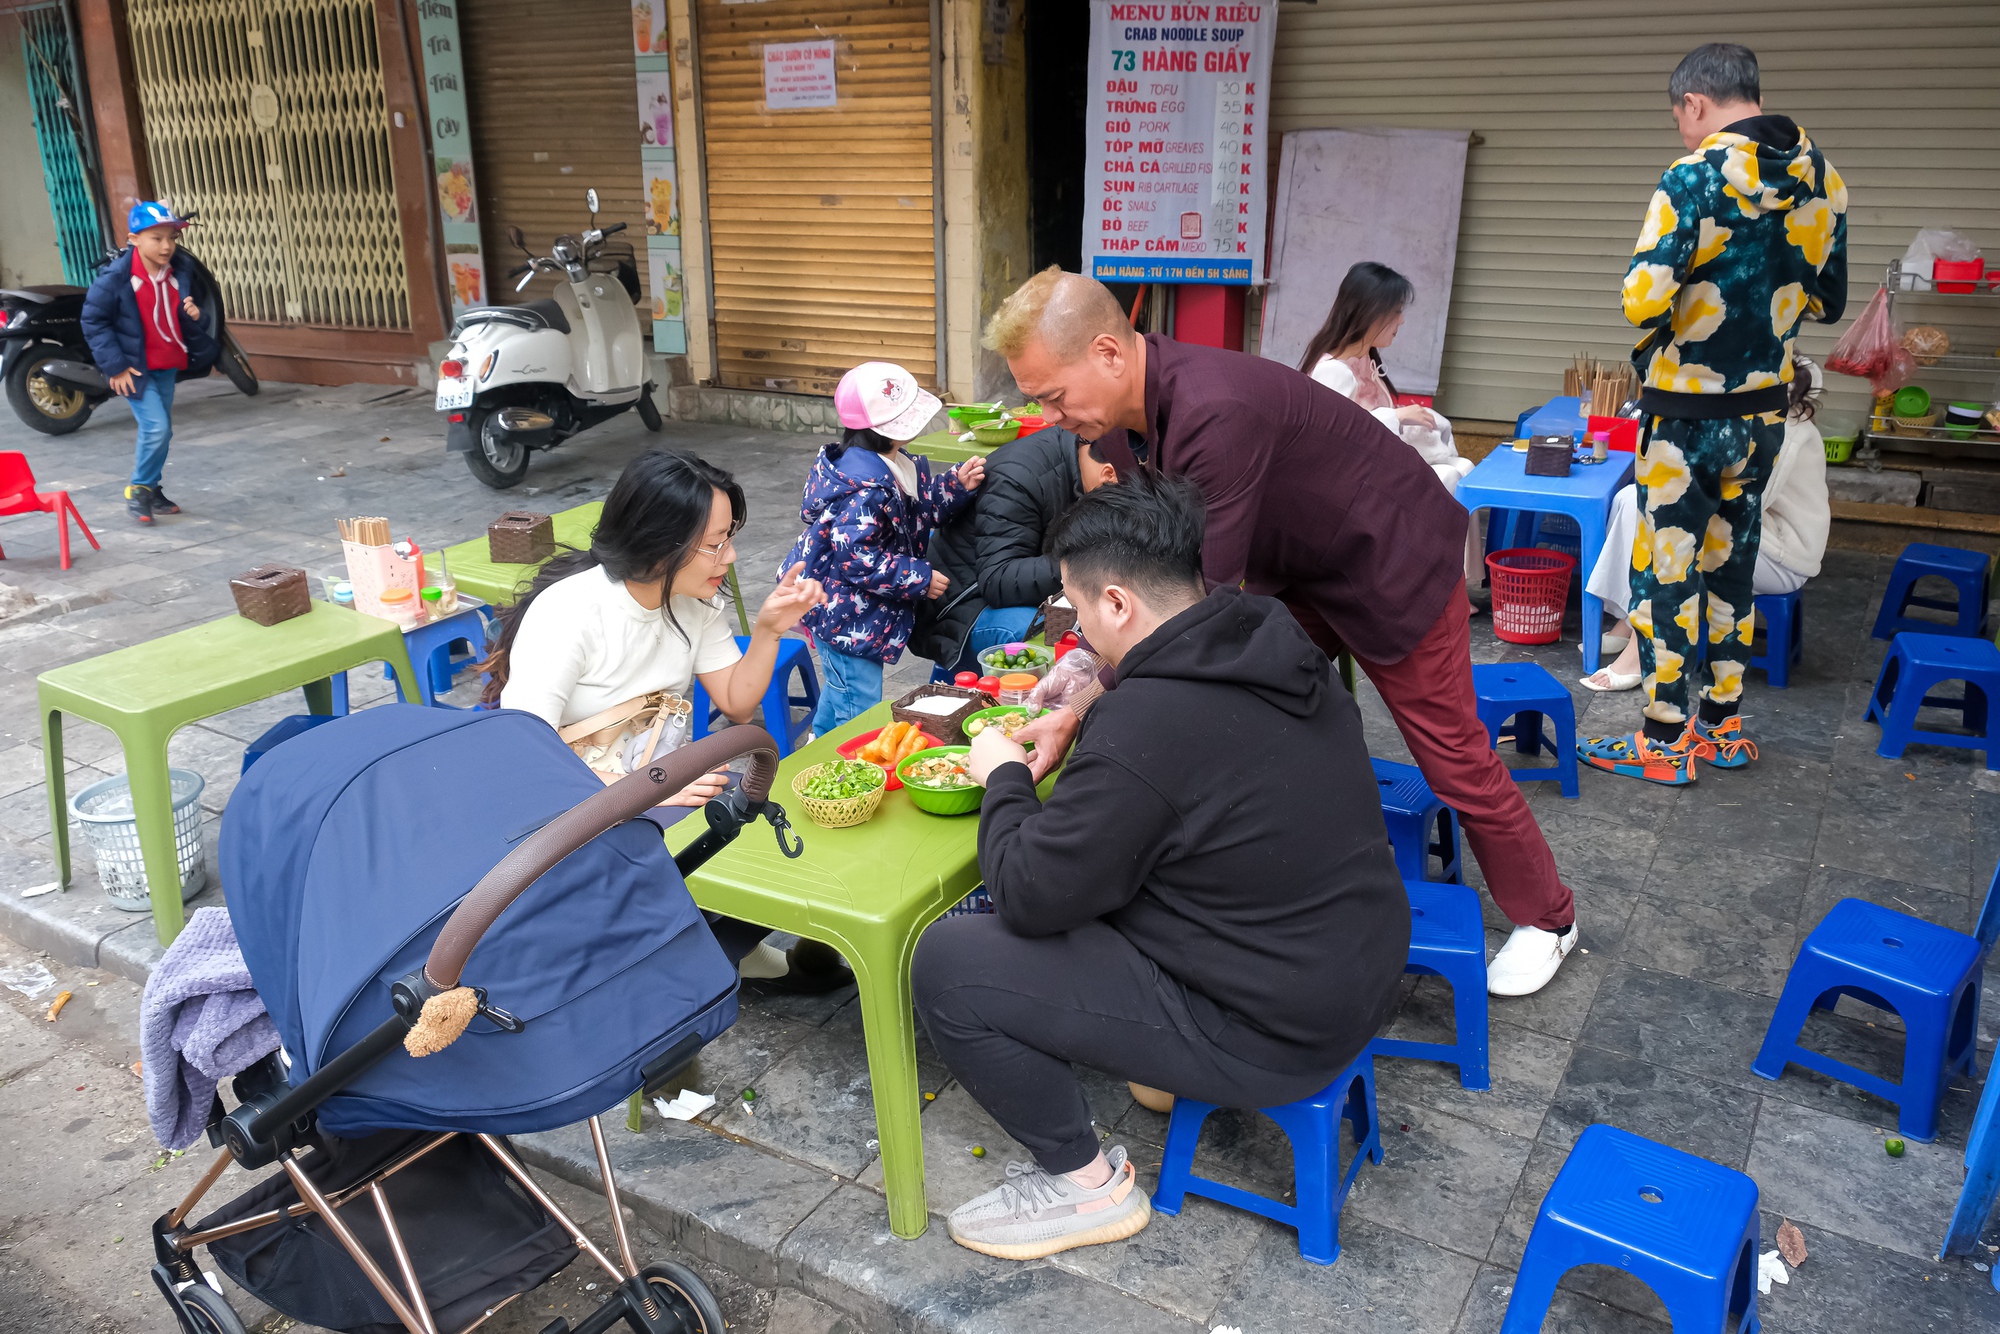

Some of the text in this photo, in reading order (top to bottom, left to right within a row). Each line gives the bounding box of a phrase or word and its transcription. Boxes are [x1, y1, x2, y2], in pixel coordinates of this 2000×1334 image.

[1110, 0, 1261, 22] MENU BÚN RIÊU
[1125, 27, 1244, 42] CRAB NOODLE SOUP
[427, 34, 451, 55] Trà
[1111, 44, 1251, 73] 73 HÀNG GIẤY
[1106, 78, 1255, 96] ĐẬU TOFU 30 K
[1106, 97, 1254, 115] TRỨNG EGG 35 K
[1105, 118, 1253, 135] GIÒ PORK 40 K
[1105, 138, 1252, 155] TÓP MỠ GREAVES 40 K
[1104, 155, 1135, 173] CHẢ
[1140, 159, 1160, 173] CÁ
[1162, 162, 1197, 174] GRILLED
[1218, 161, 1238, 174] 40
[1241, 163, 1251, 175] K
[1103, 180, 1250, 195] SỤN RIB CARTILAGE 40 K
[1103, 195, 1249, 214] ỐC SNAILS 45 K
[1102, 216, 1247, 234] BÒ BEEF 45 K
[1101, 236, 1140, 253] THẬP
[1213, 238, 1231, 253] 75
[1236, 241, 1246, 253] K
[1096, 264, 1116, 277] BÁN
[1119, 264, 1145, 278] HÀNG
[1165, 267, 1183, 278] 17H
[1185, 264, 1205, 278] ĐẾN
[1207, 268, 1220, 278] 5H
[1222, 264, 1249, 279] SÁNG
